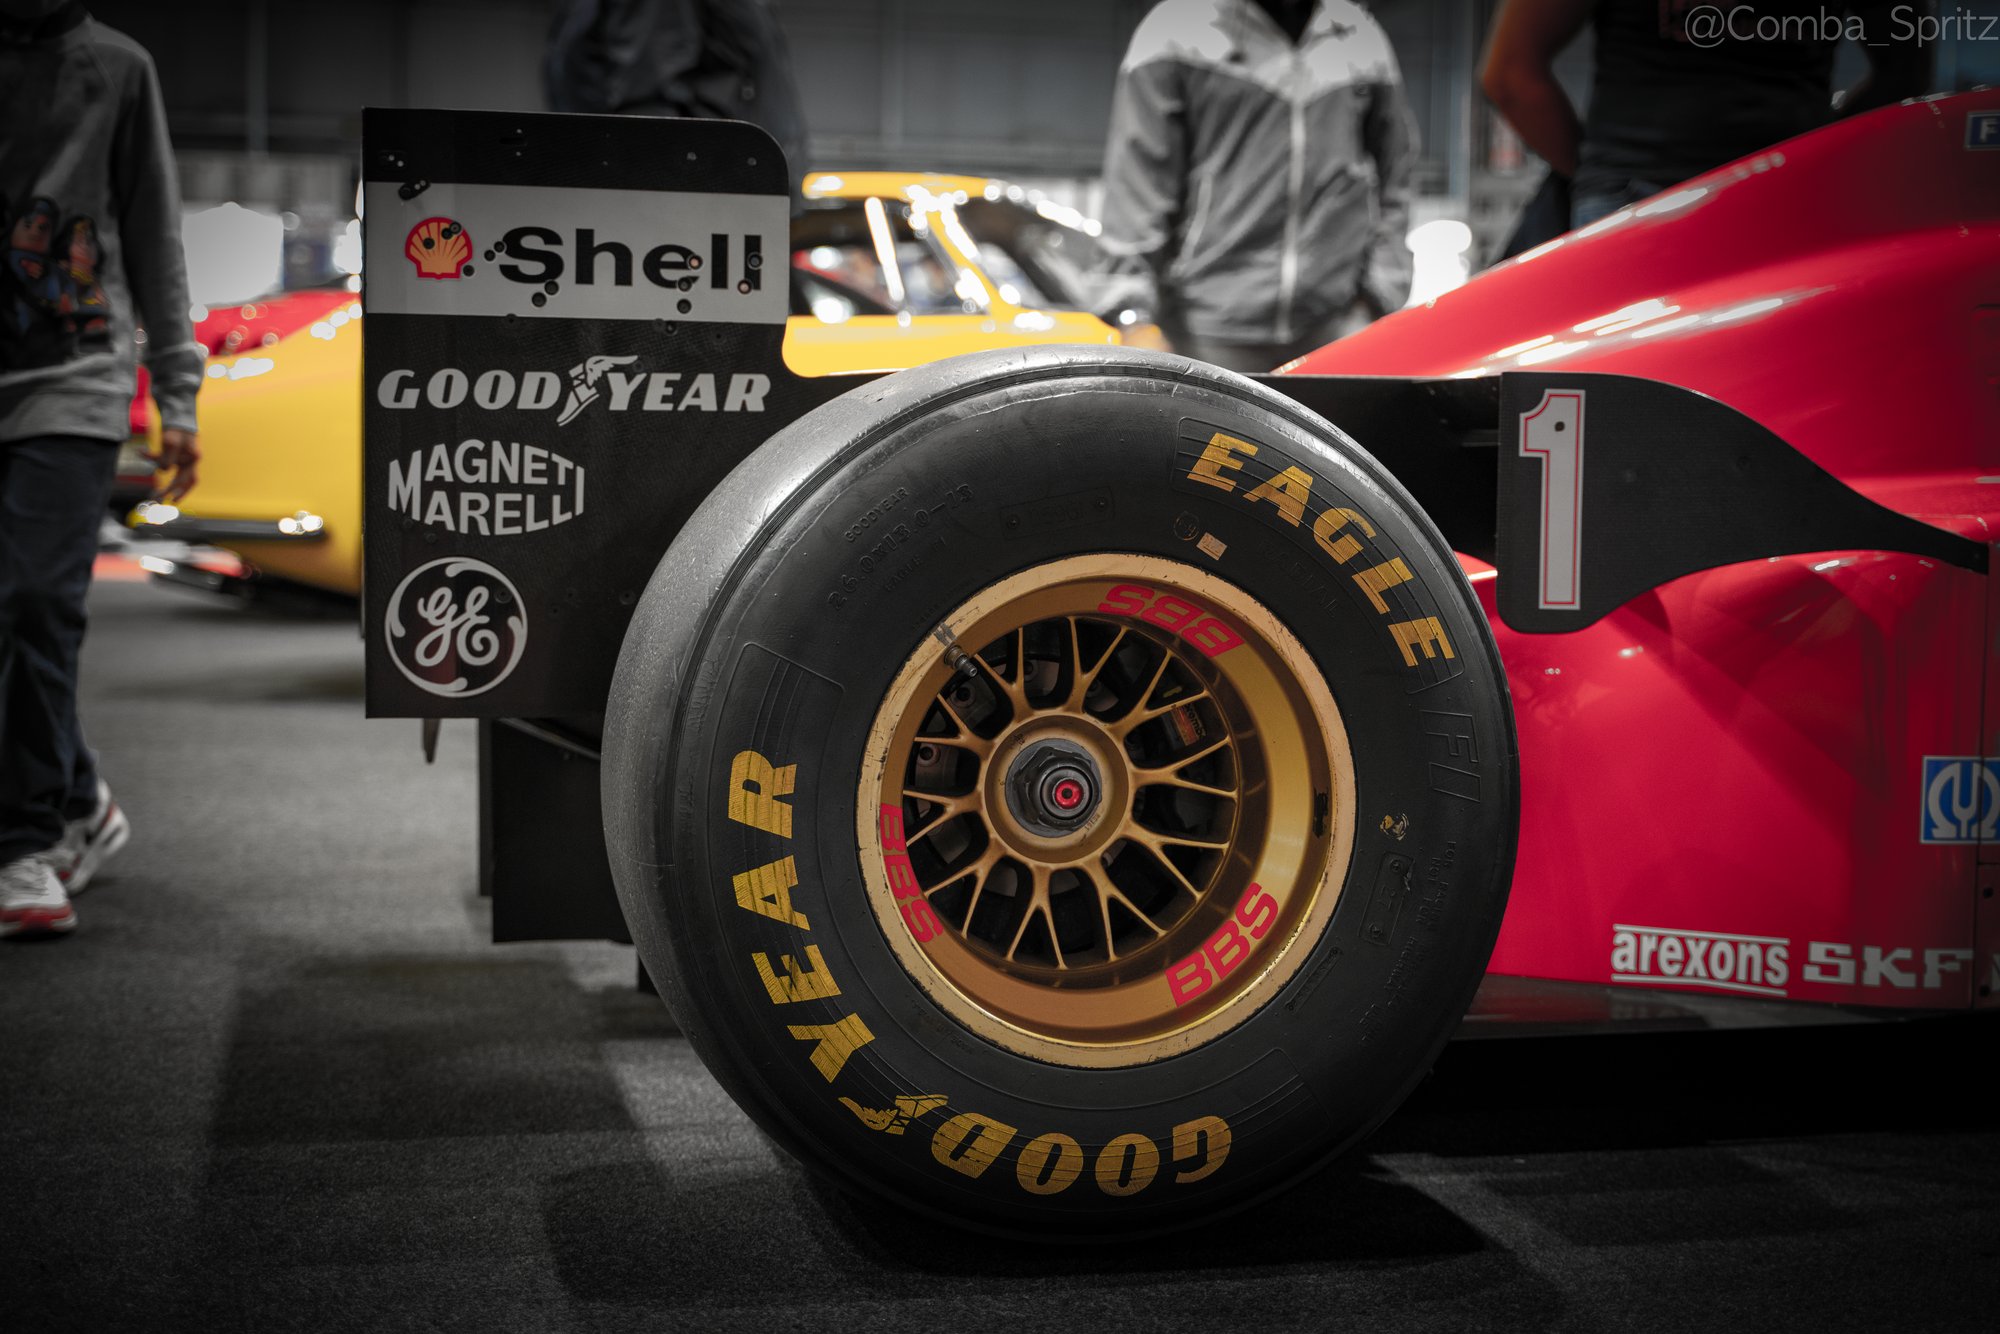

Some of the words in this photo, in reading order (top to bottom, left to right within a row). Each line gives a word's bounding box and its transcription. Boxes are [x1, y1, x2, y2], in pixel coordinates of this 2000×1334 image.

[500, 226, 762, 291] Shell
[388, 439, 585, 510] MAGNETI
[388, 472, 585, 536] MARELLI
[1519, 388, 1586, 610] 1
[844, 487, 911, 543] GOODYEAR
[1186, 432, 1455, 667] EAGLE
[414, 585, 500, 668] GE
[1097, 584, 1245, 658] BBS
[880, 802, 943, 943] BBS
[1165, 883, 1279, 1007] BBS
[1612, 930, 1791, 987] arexons
[1802, 940, 1974, 989] SKF
